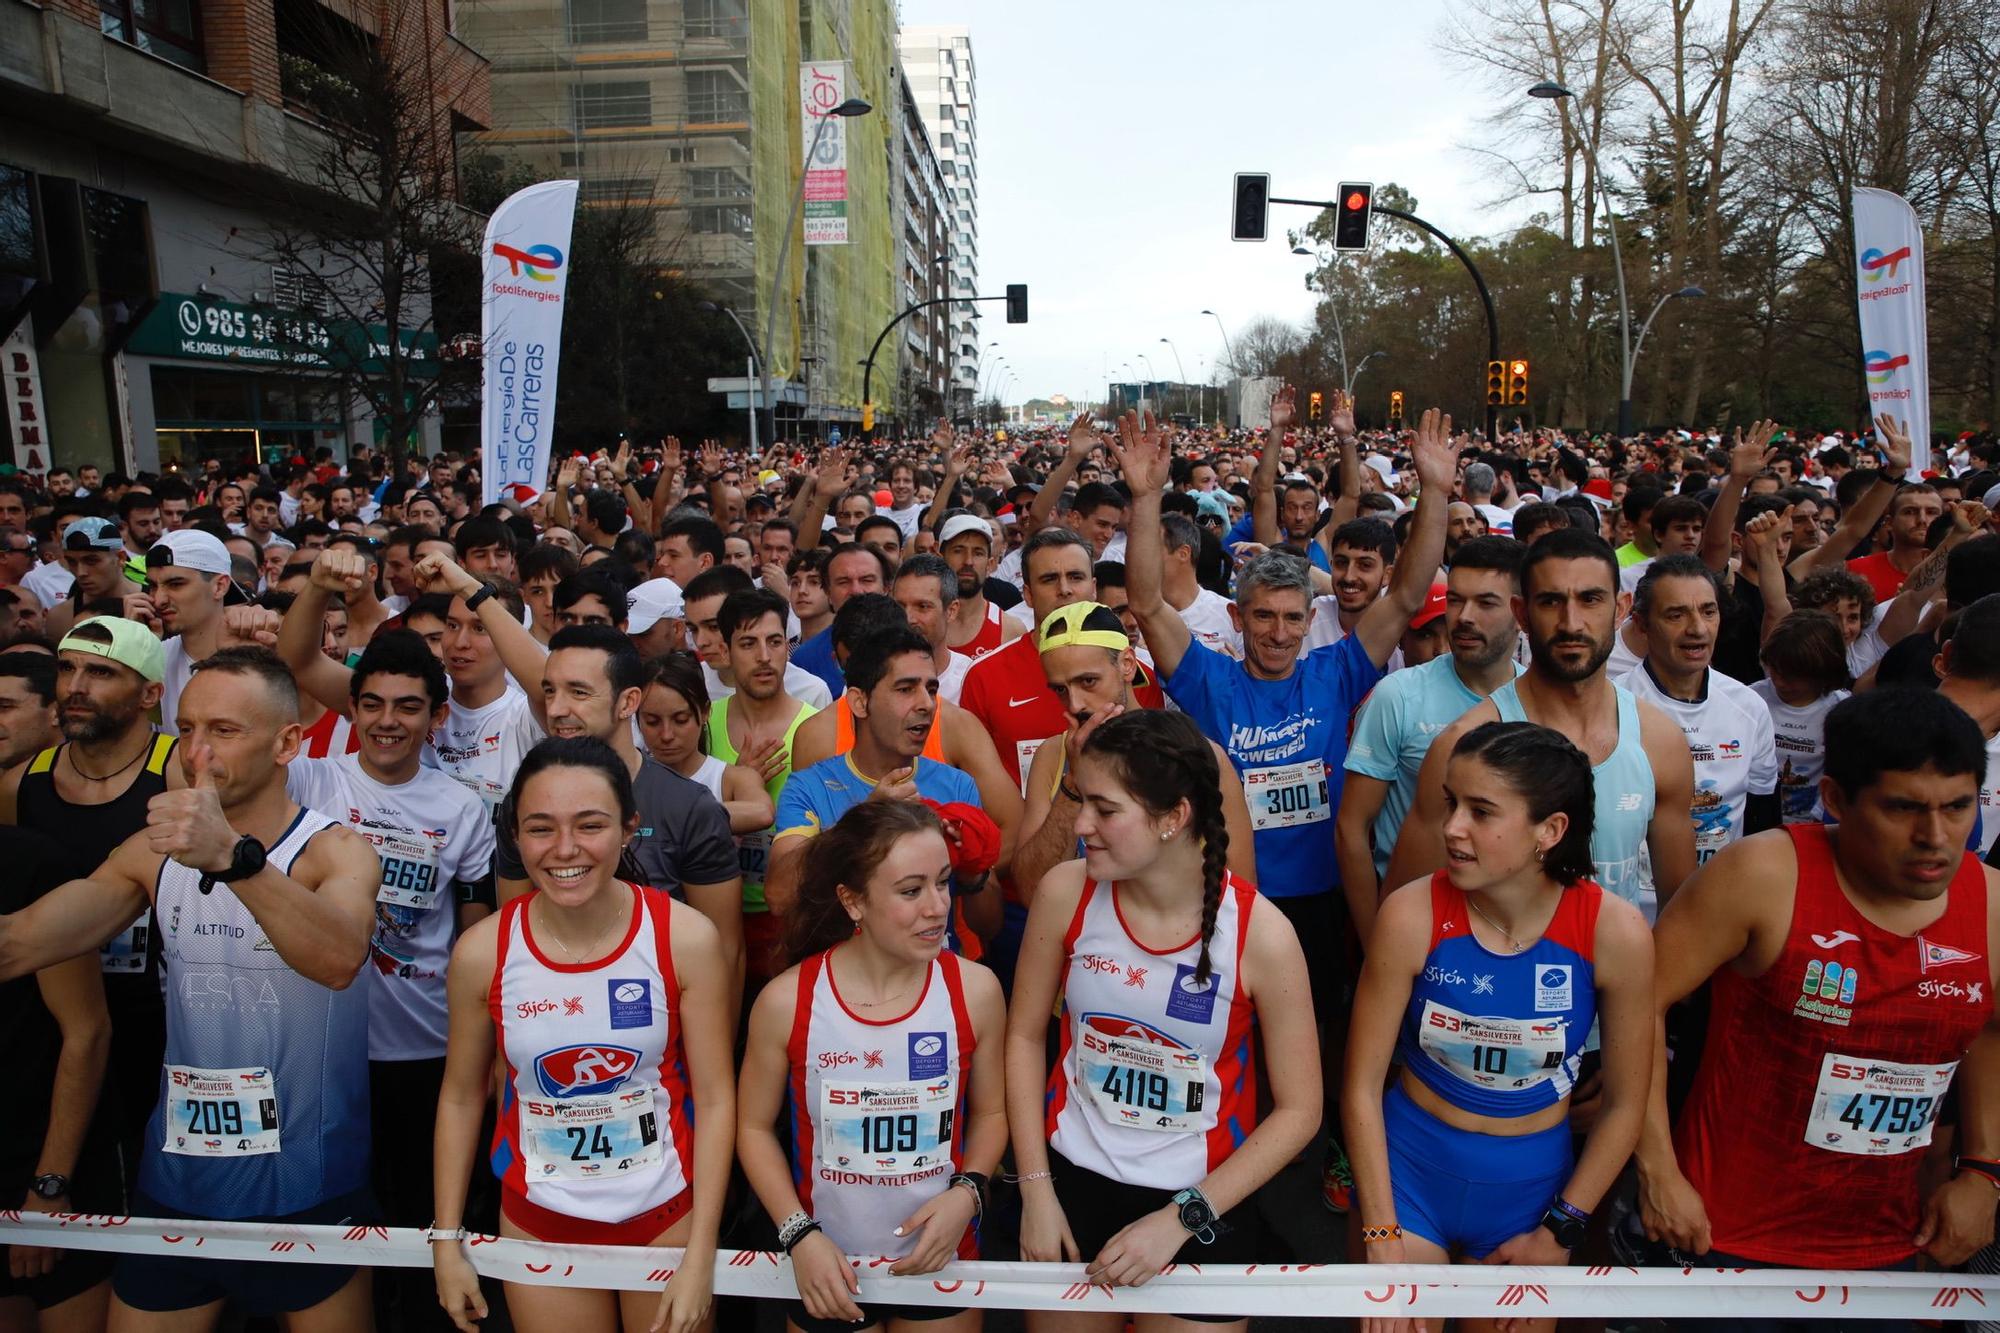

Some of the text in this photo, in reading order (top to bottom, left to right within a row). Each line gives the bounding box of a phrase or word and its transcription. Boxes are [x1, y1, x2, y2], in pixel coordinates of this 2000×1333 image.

[492, 283, 561, 303] TotalEnergies
[205, 307, 246, 339] 985
[181, 340, 223, 355] MEJORES
[514, 343, 546, 485] LasCarreras
[1227, 732, 1307, 763] POWERED
[1248, 773, 1267, 784] 53
[1266, 784, 1311, 815] 300
[379, 854, 433, 893] 669
[193, 923, 246, 939] ALTITUD
[1082, 954, 1122, 976] gijón
[1424, 965, 1467, 986] gijón
[1917, 980, 1965, 999] gijón
[516, 998, 559, 1019] gijón
[1795, 994, 1853, 1019] Asturias
[1429, 1011, 1462, 1032] 53
[1083, 1033, 1107, 1055] 53
[1469, 1029, 1523, 1041] SANSILVESTRE
[818, 1051, 859, 1070] gijón
[1116, 1049, 1165, 1067] SANSILVESTRE
[1473, 1045, 1508, 1075] 10
[171, 1071, 190, 1087] 53
[1830, 1062, 1867, 1081] 53
[1874, 1074, 1926, 1087] SANSILVESTRE
[193, 1081, 234, 1092] SANSILVESTRE
[828, 1089, 860, 1105] 53
[1101, 1065, 1169, 1112] 4119
[527, 1101, 555, 1118] 53
[868, 1095, 919, 1106] SANSILVESTRE
[186, 1099, 244, 1135] 209
[563, 1106, 614, 1119] SANSILVESTRE
[1839, 1093, 1934, 1134] 4793
[566, 1124, 614, 1162] 24
[861, 1114, 918, 1154] 109
[877, 1166, 944, 1187] ATLETISMO
